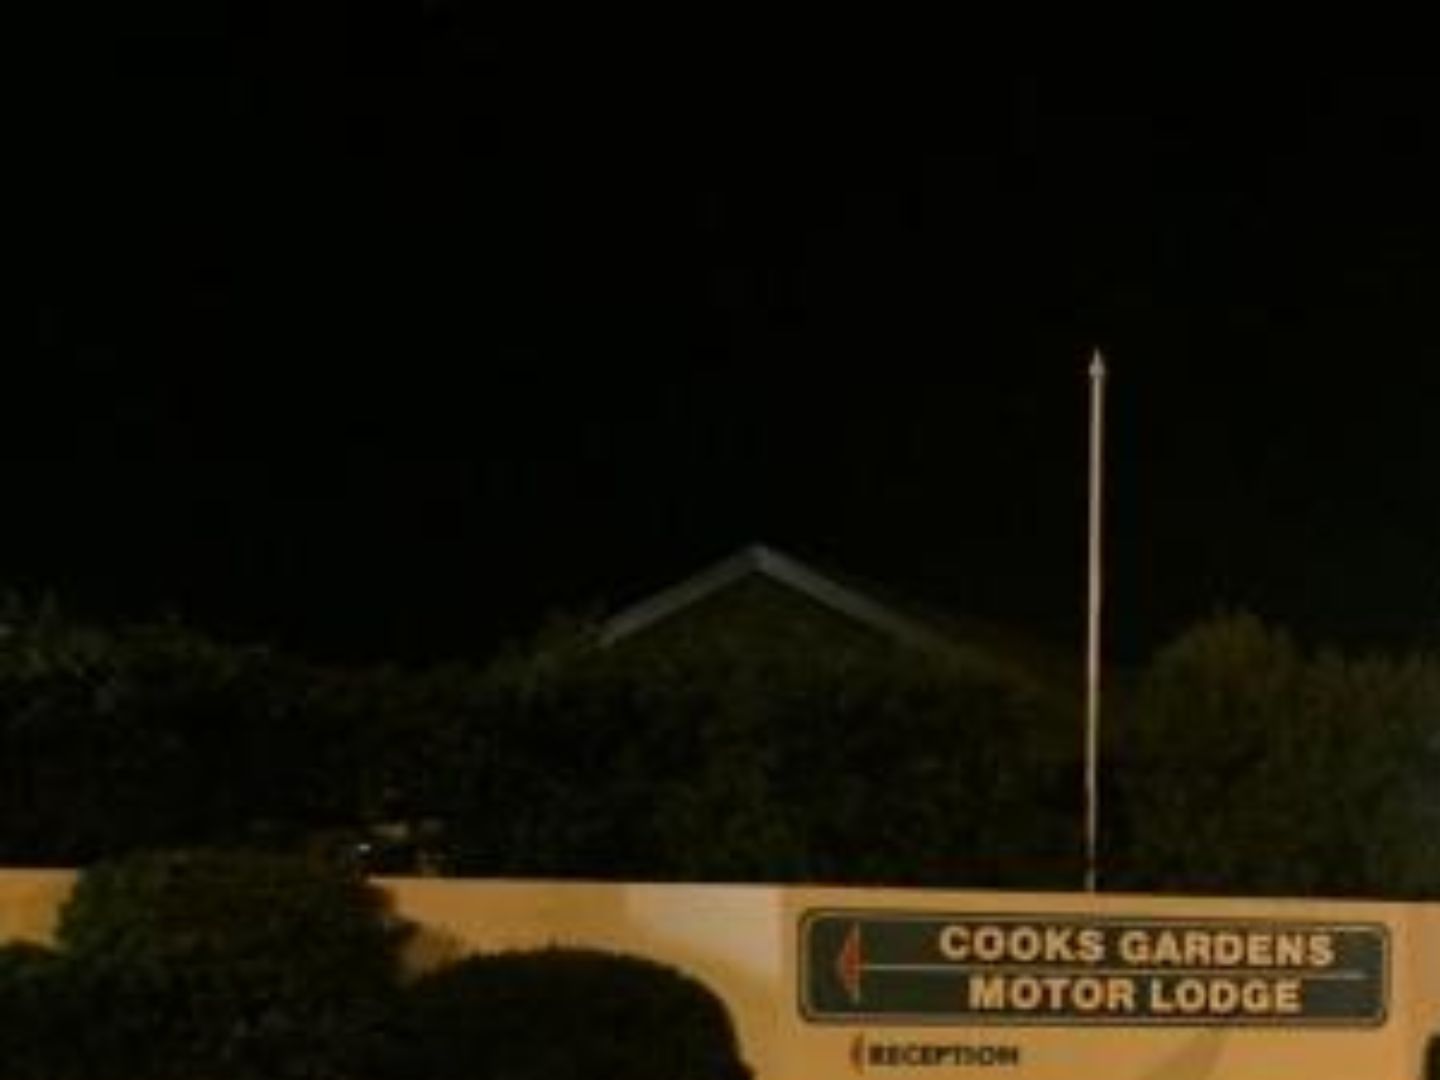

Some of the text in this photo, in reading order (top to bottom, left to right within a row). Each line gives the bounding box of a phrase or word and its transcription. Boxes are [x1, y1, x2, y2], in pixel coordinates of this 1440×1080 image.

[938, 925, 1336, 967] COOKS GARDENS
[968, 977, 1302, 1014] MOTOR LODGE
[867, 1044, 1020, 1066] RECEPTION
